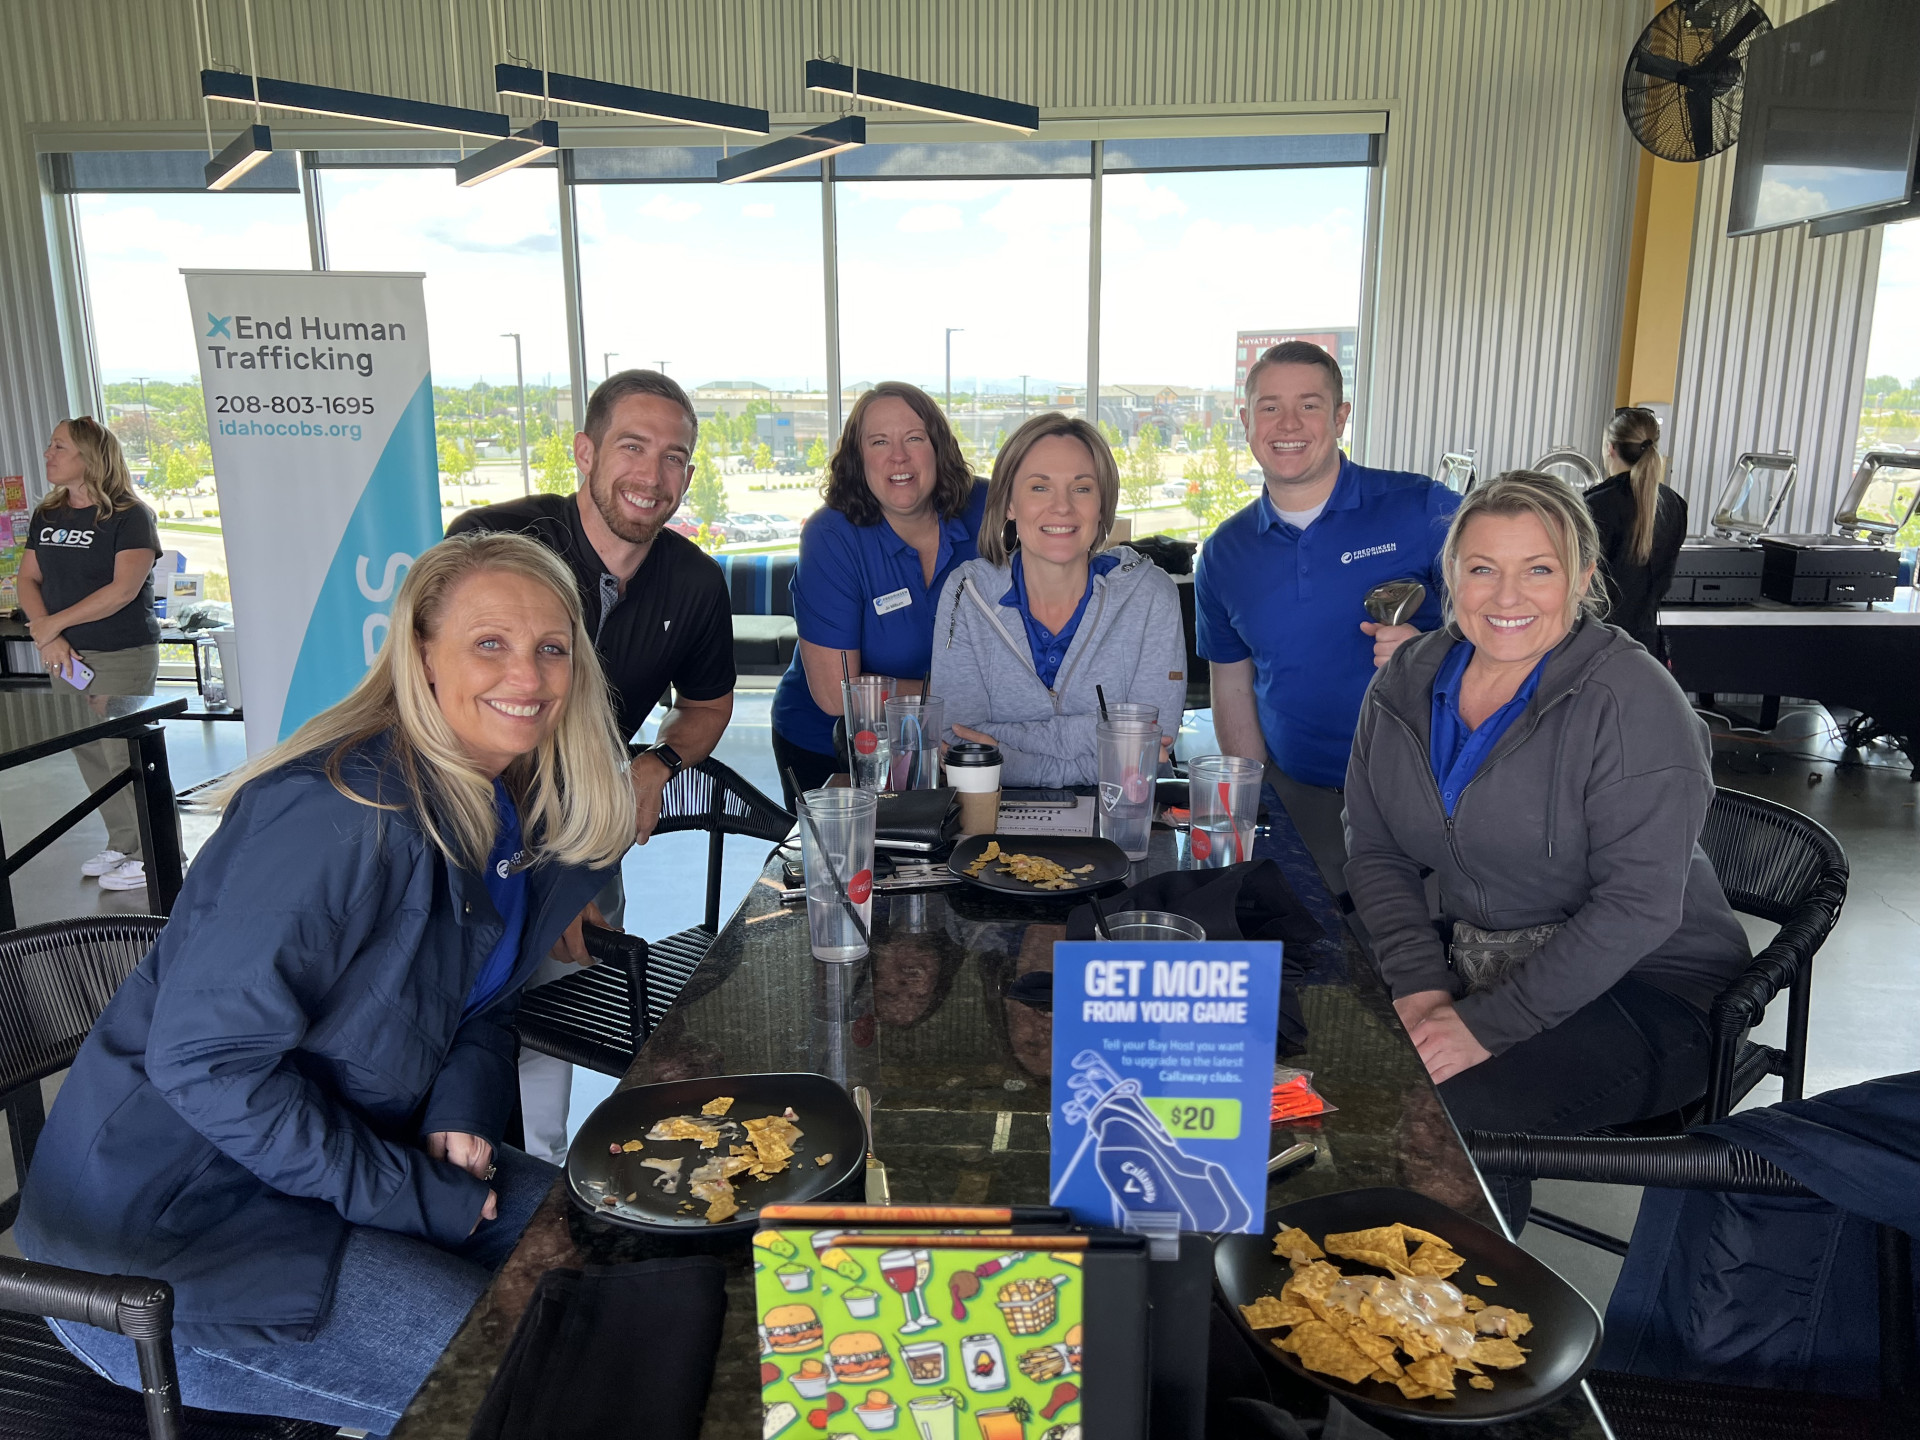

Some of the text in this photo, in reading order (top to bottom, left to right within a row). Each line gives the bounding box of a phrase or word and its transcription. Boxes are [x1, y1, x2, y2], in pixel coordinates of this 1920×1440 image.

[235, 315, 406, 341] End Human
[1244, 337, 1269, 345] HYATT
[207, 345, 374, 378] Trafficking
[214, 395, 375, 415] 208-803-1695
[218, 419, 362, 441] idahocobs.org
[40, 526, 95, 546] COBS
[1084, 959, 1250, 998] GET MORE
[1082, 1000, 1248, 1024] FROM YOUR GAME
[1102, 1038, 1244, 1053] Tell your Bay Host you want
[1121, 1055, 1243, 1069] to upgrade to the latest
[1158, 1070, 1242, 1085] Callaway clubs.
[1171, 1105, 1215, 1131] $20
